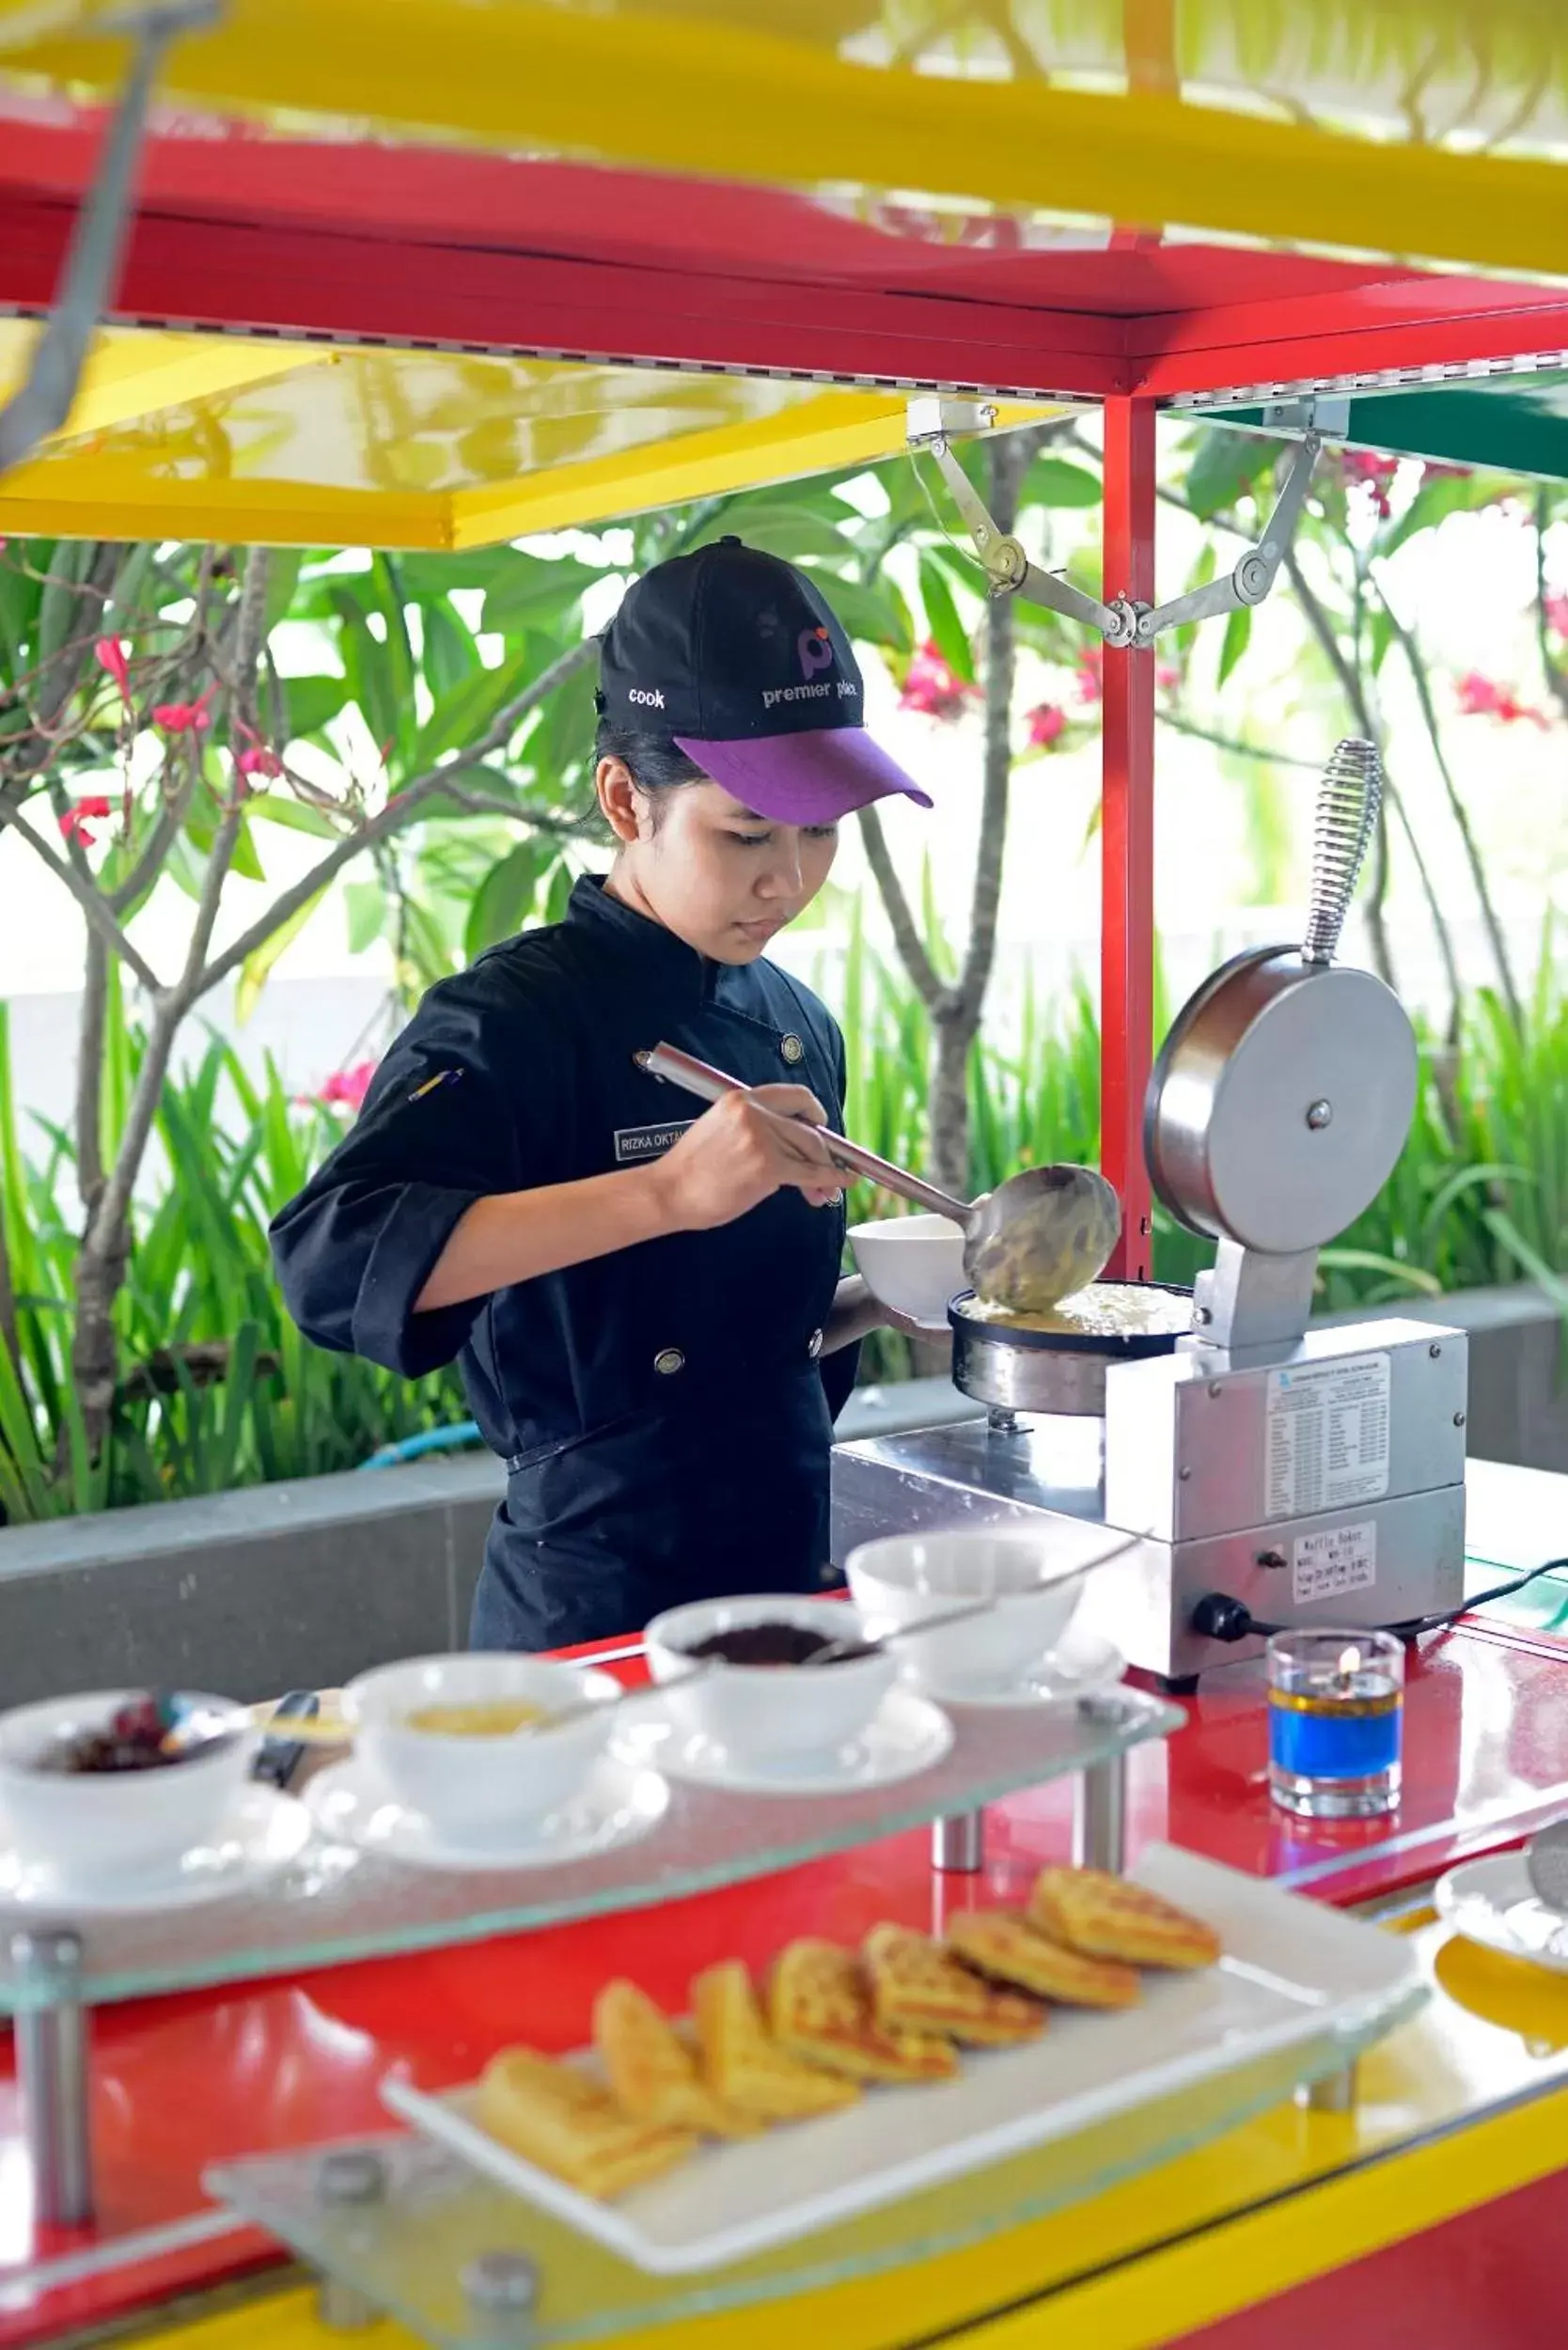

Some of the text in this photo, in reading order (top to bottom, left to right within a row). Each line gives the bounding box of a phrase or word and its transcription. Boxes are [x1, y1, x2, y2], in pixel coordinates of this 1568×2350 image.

[629, 688, 665, 709] cook
[762, 682, 830, 708] premier
[620, 1135, 653, 1152] RIZKA
